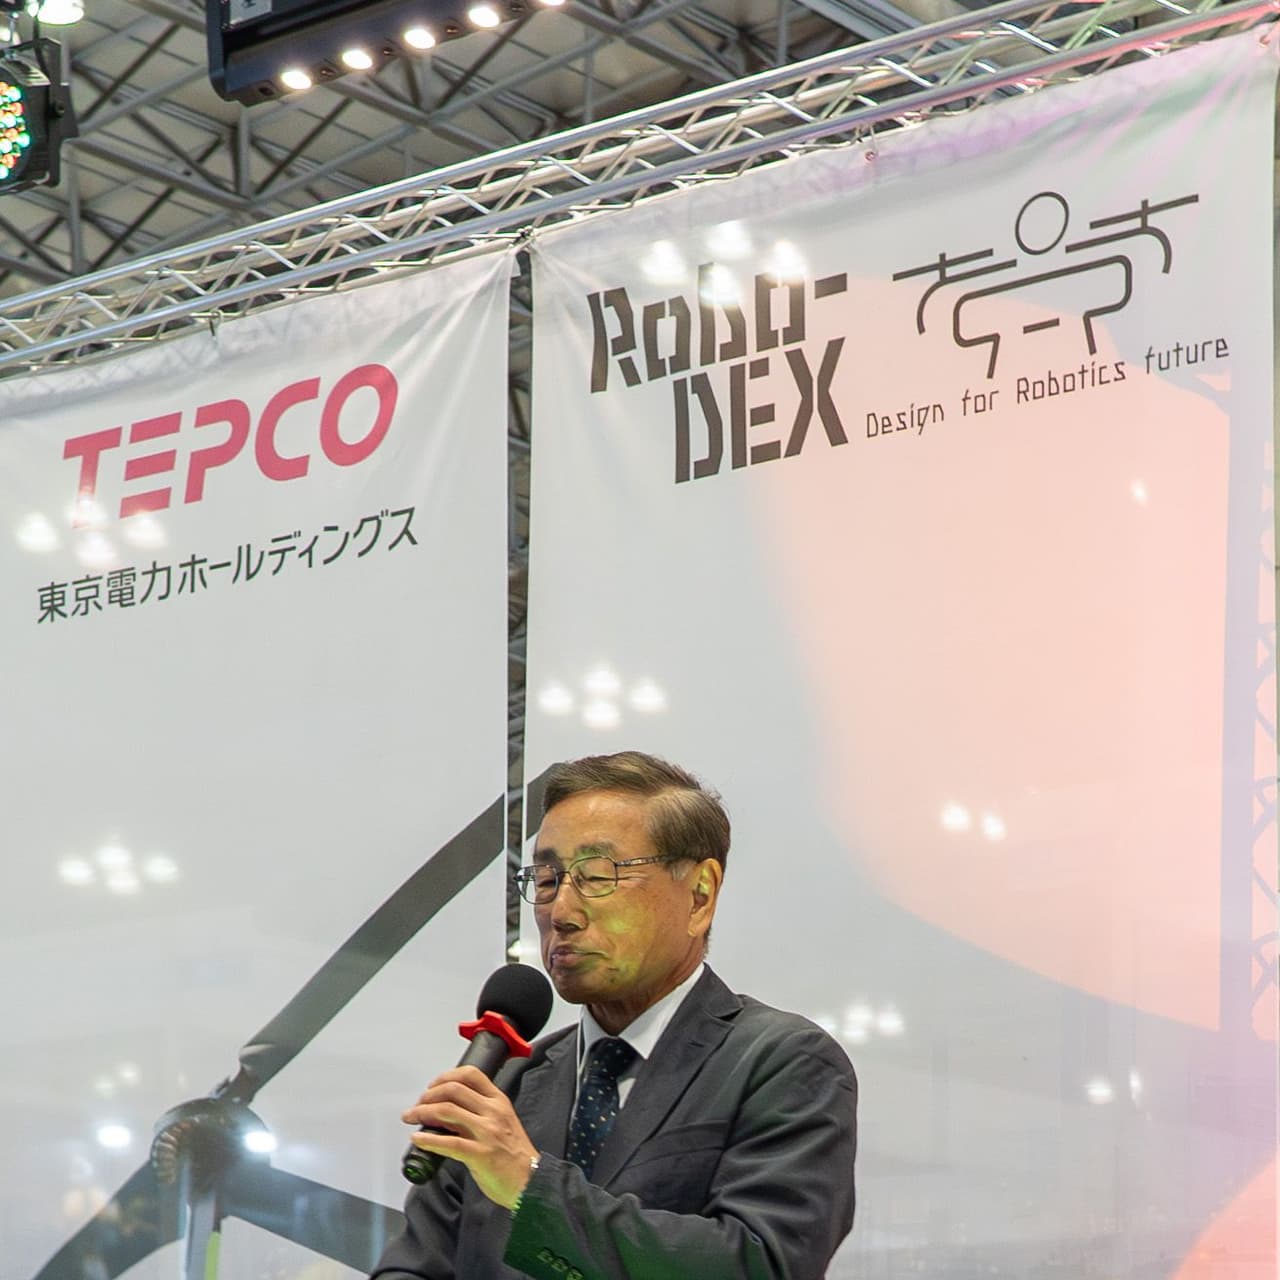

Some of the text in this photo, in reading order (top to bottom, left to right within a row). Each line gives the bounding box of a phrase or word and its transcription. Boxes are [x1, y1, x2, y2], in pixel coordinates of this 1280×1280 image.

[63, 363, 399, 529] TEPCO
[673, 336, 849, 484] DEX
[866, 337, 1230, 438] Design for Robotics future
[37, 506, 419, 624] 東京電力ホールディングス
